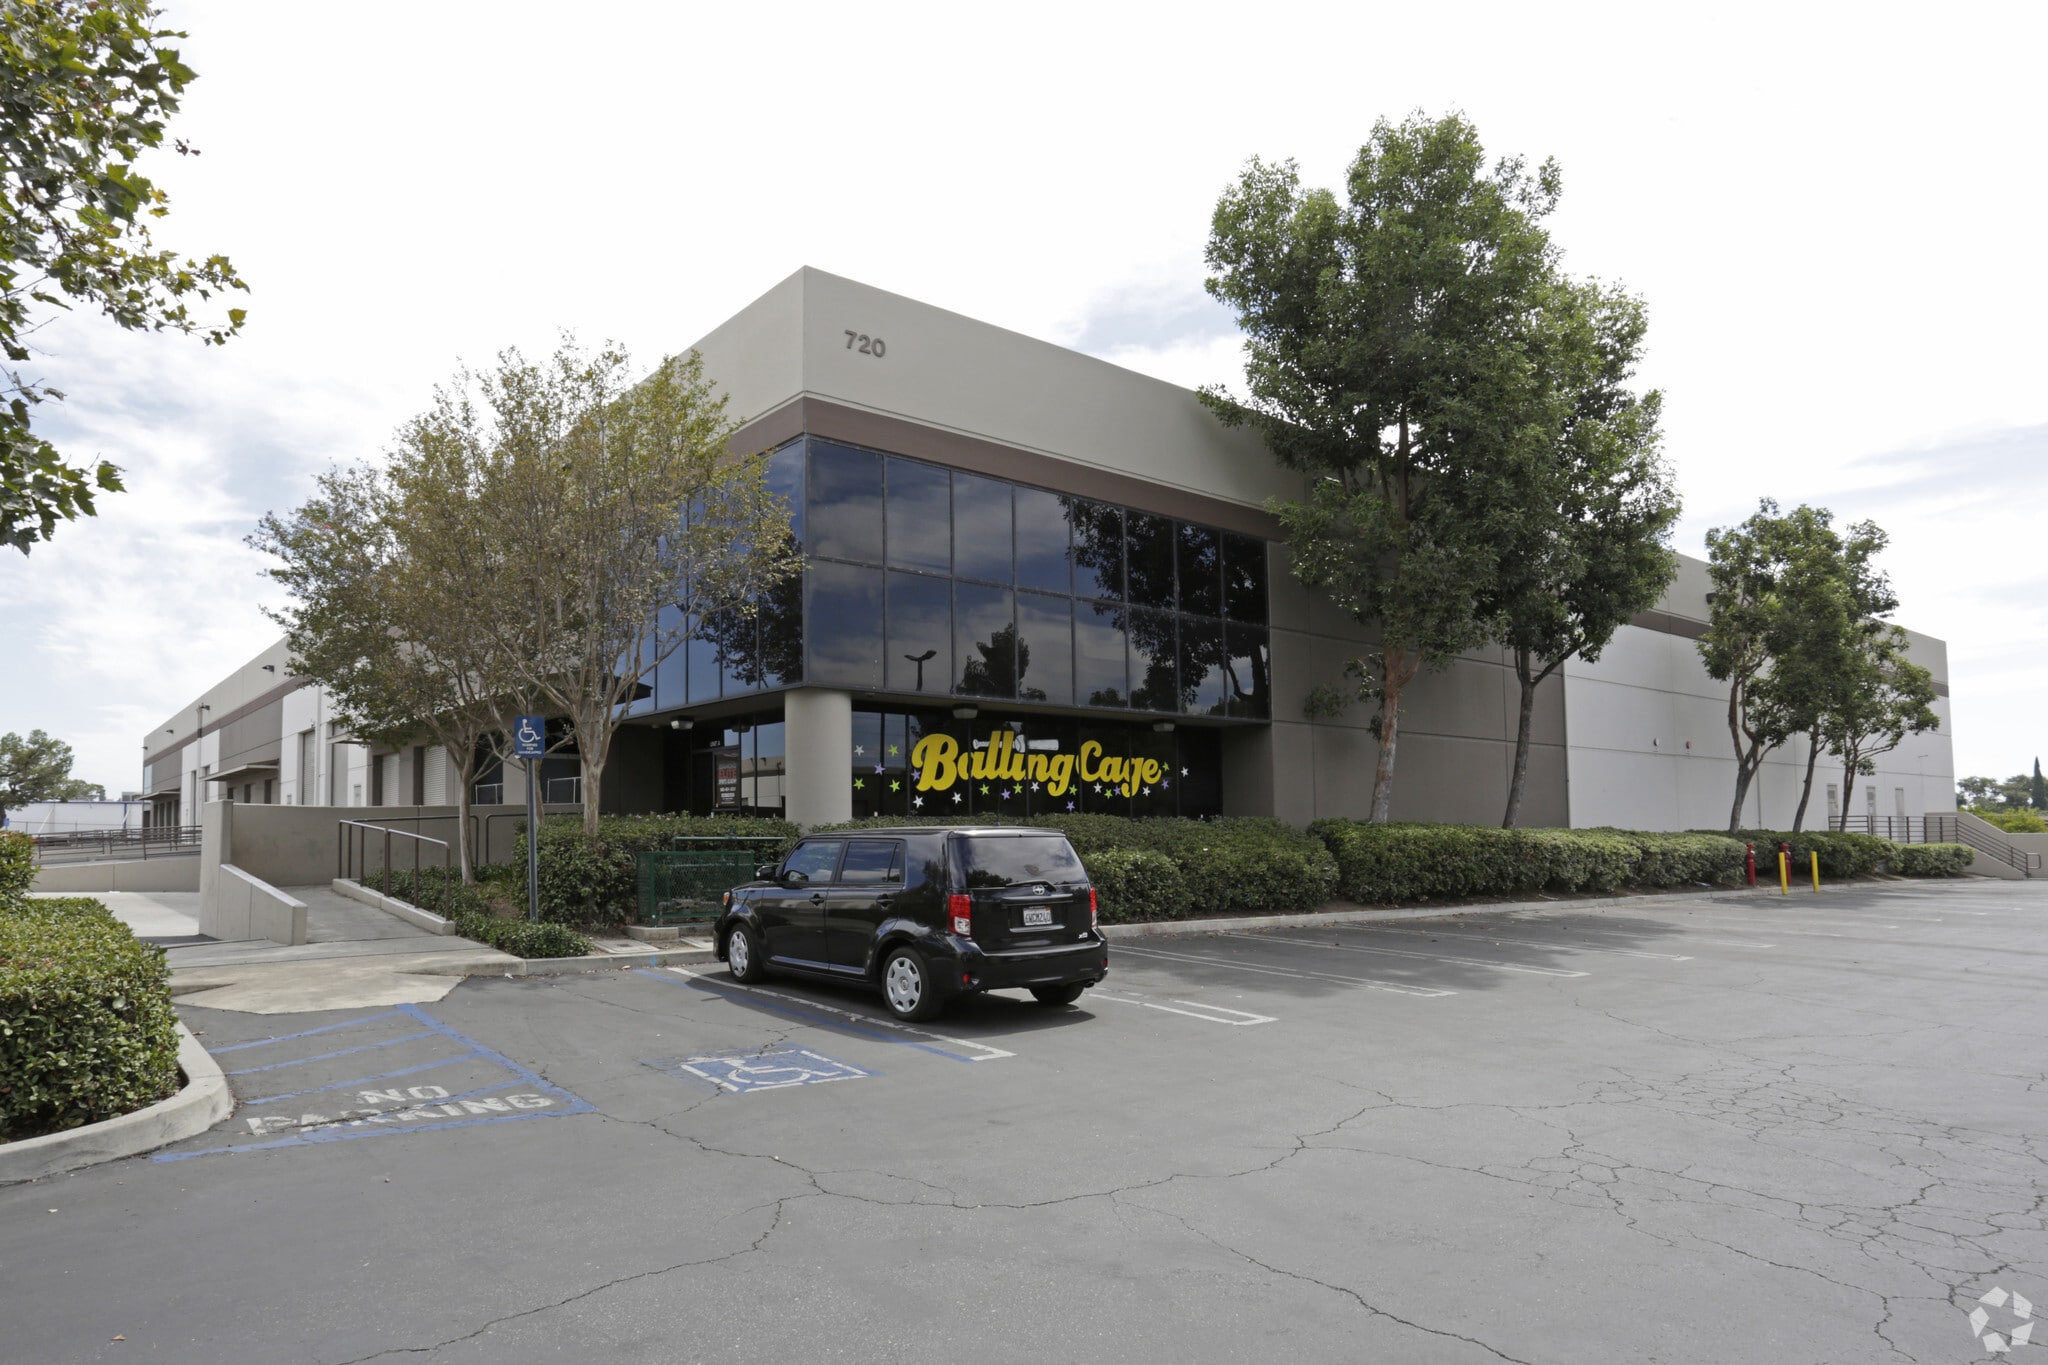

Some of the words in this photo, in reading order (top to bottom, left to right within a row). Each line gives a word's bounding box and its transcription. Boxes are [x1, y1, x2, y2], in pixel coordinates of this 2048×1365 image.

[844, 329, 886, 358] 720
[911, 731, 1076, 797] Batting
[1076, 740, 1162, 798] Cage
[358, 1085, 450, 1104] NO
